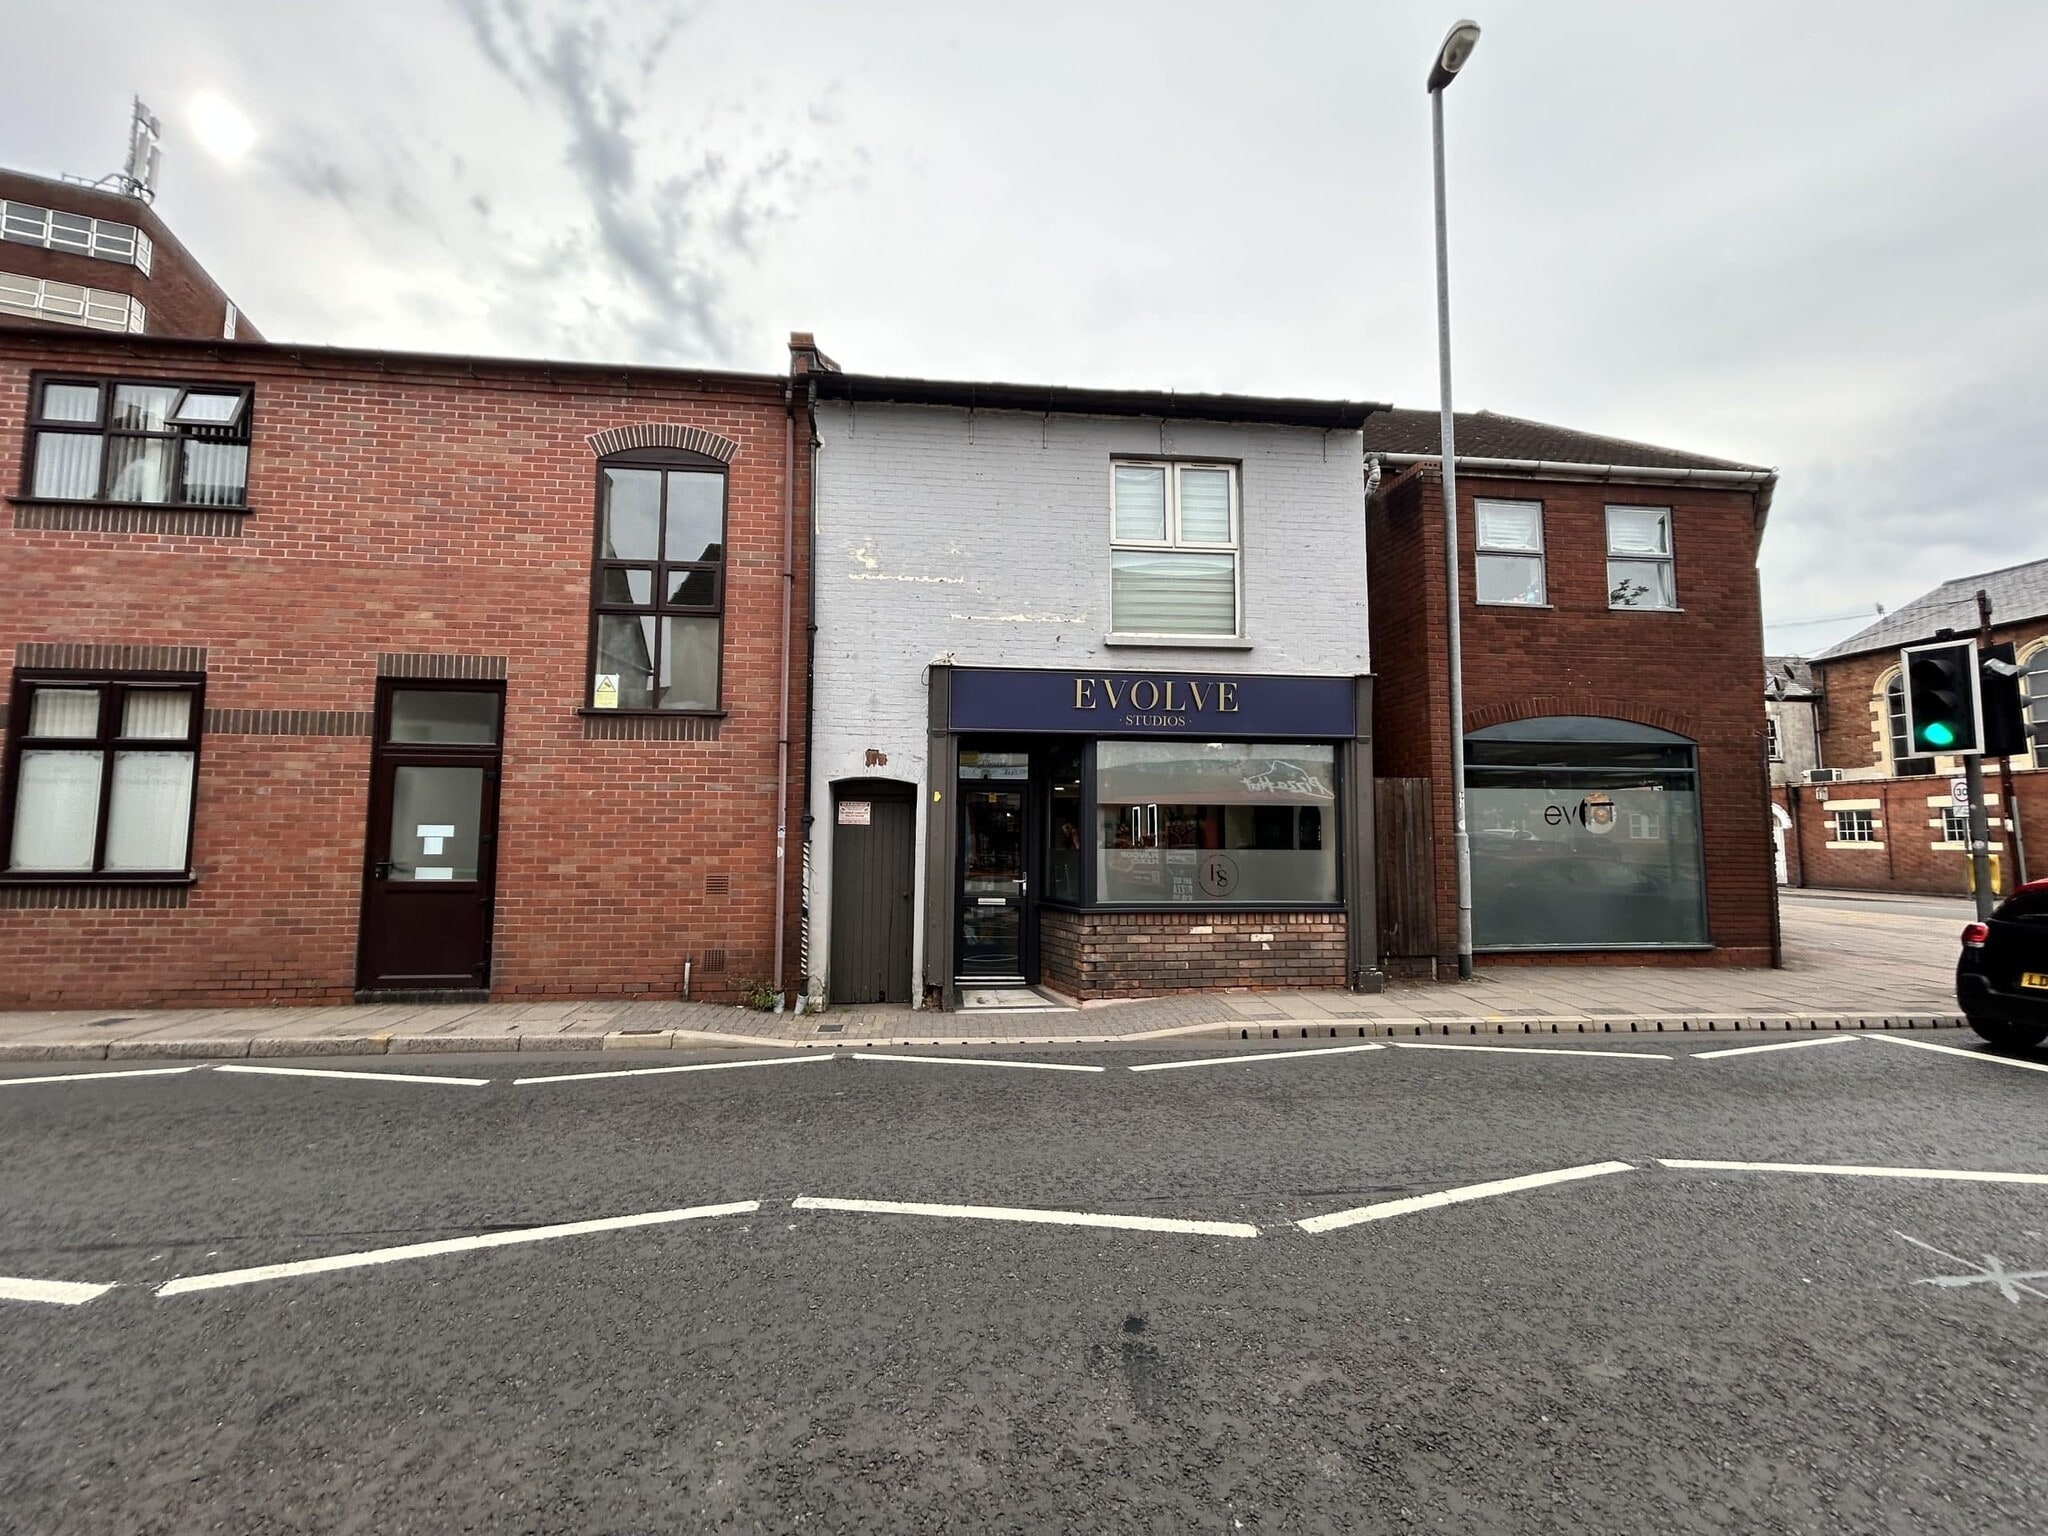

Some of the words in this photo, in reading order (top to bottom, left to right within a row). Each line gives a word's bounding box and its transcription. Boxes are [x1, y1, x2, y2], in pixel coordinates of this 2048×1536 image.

[1072, 678, 1239, 712] EVOLVE
[1125, 715, 1186, 727] STUDIOS
[1956, 788, 1968, 797] 30
